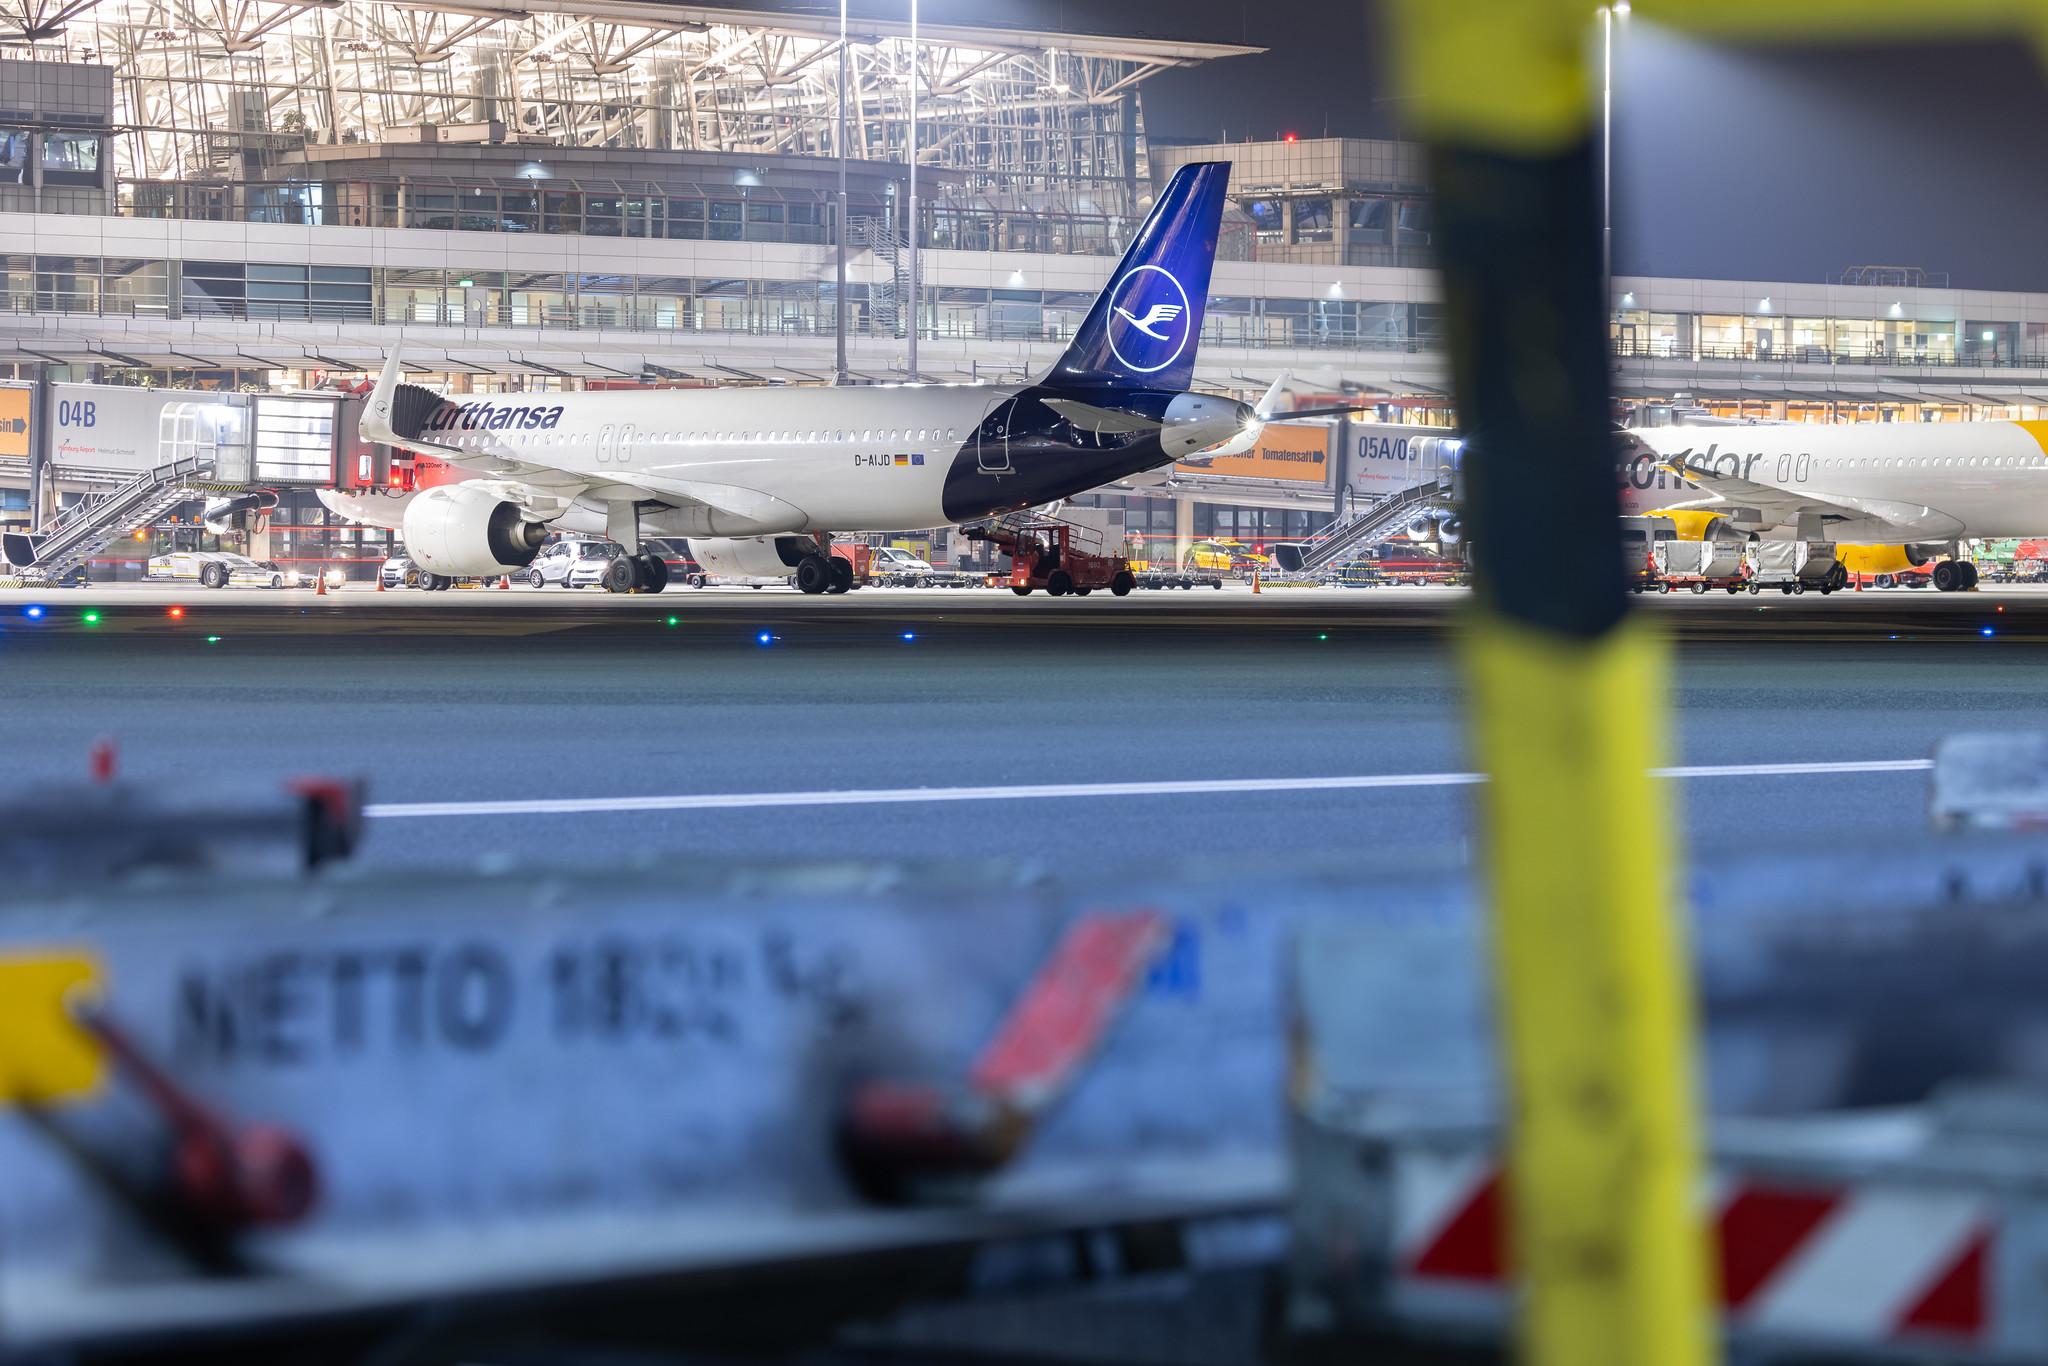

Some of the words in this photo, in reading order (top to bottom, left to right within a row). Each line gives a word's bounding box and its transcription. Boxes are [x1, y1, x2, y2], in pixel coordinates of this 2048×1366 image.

[59, 400, 96, 428] 04B
[854, 454, 890, 466] D-AIJD
[173, 938, 517, 1066] NETTO
